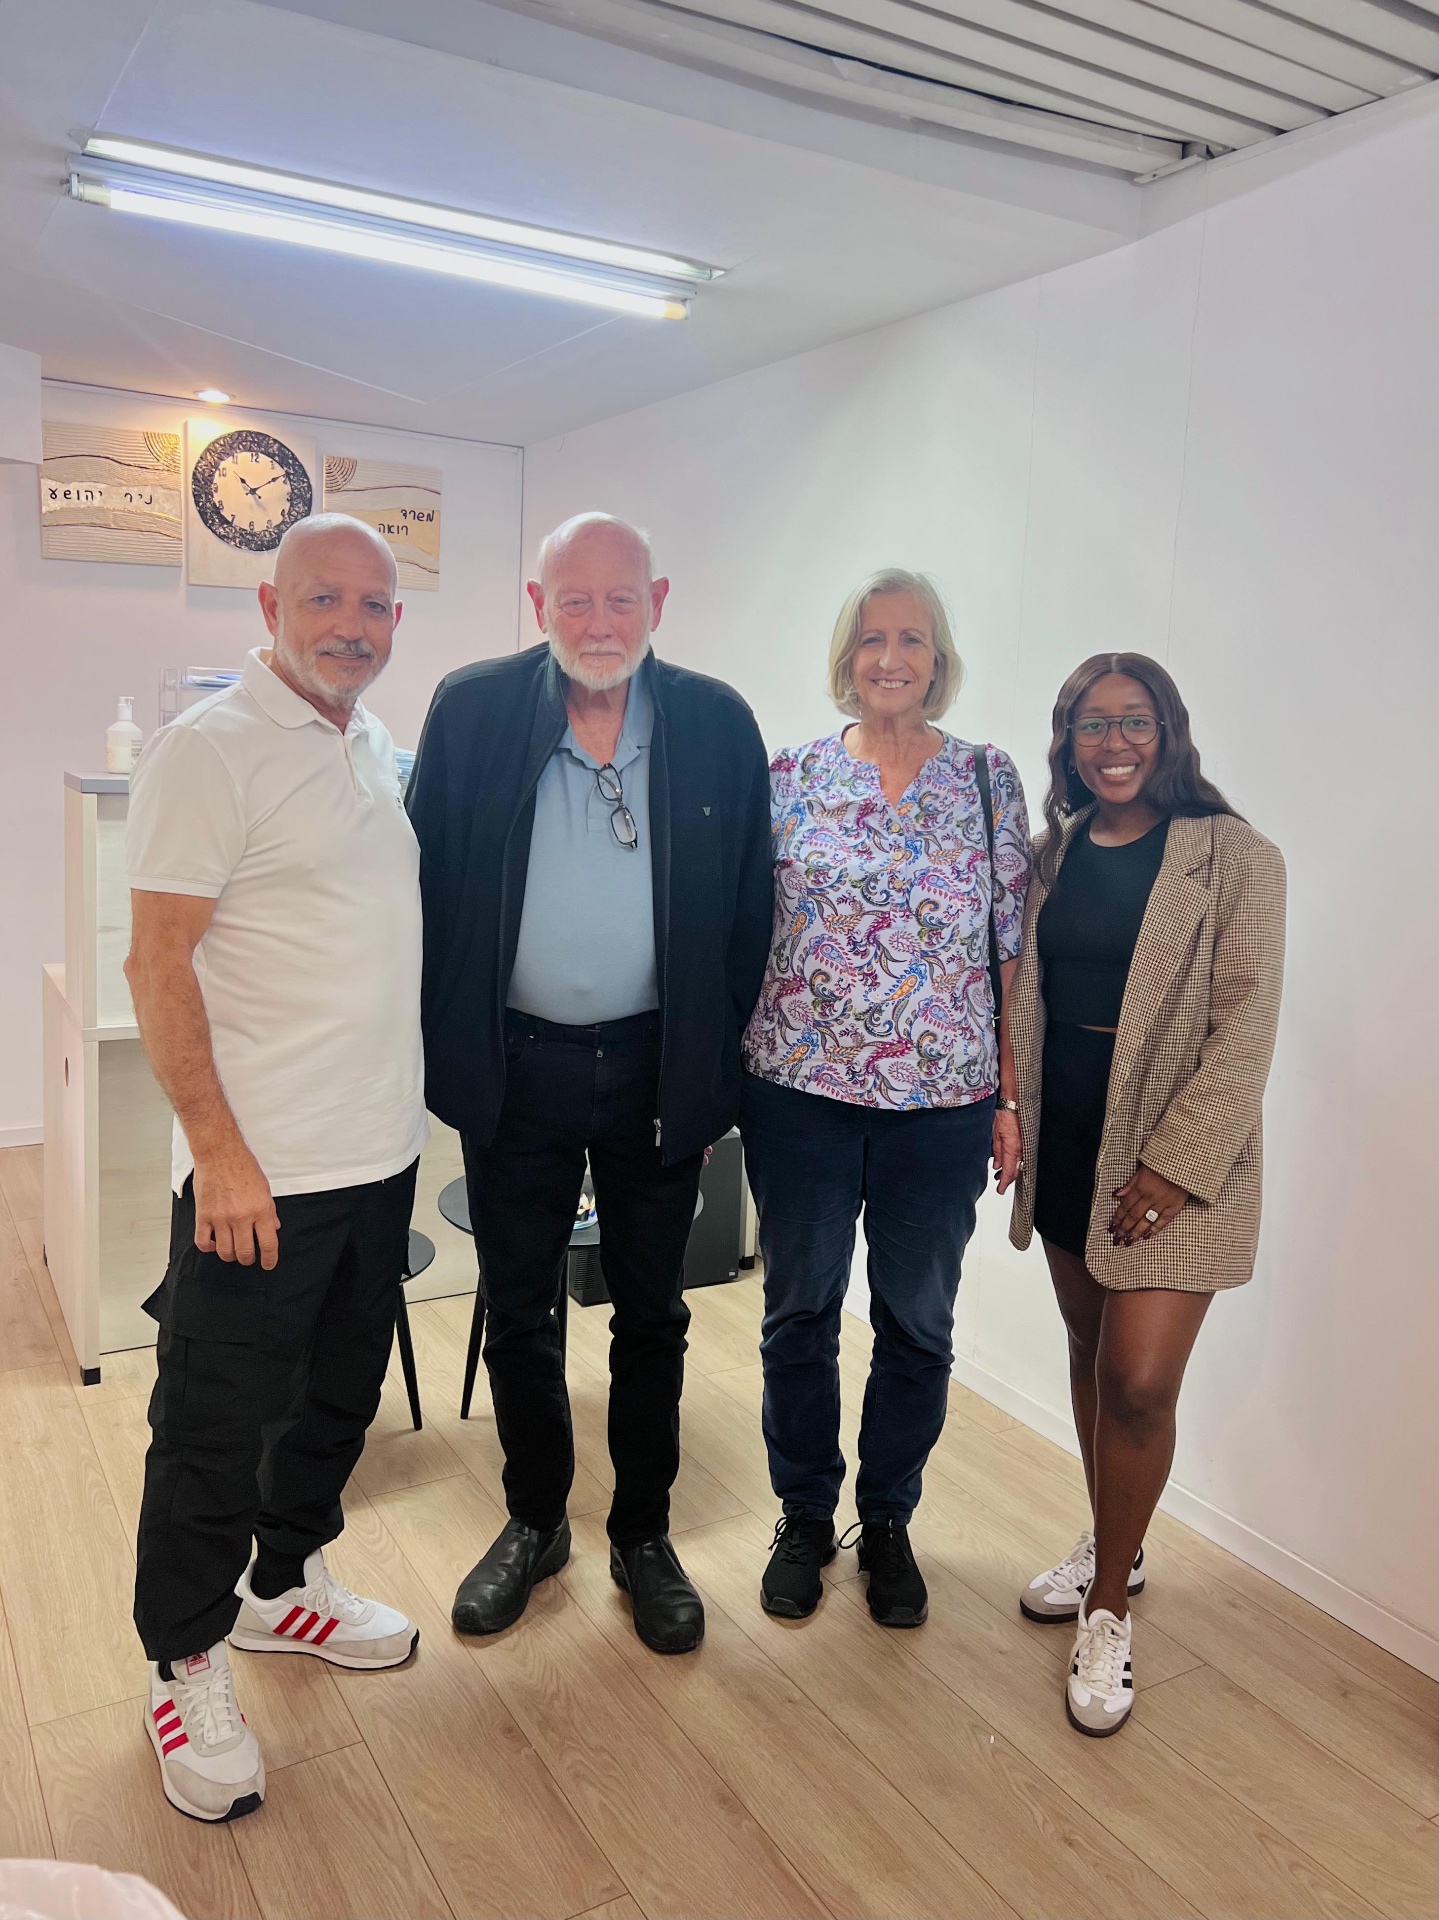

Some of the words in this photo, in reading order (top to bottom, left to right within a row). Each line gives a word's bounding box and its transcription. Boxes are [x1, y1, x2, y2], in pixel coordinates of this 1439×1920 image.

[250, 452, 259, 463] 12
[218, 467, 227, 477] 10
[48, 487, 103, 500] יהושע
[378, 523, 409, 536] רואה
